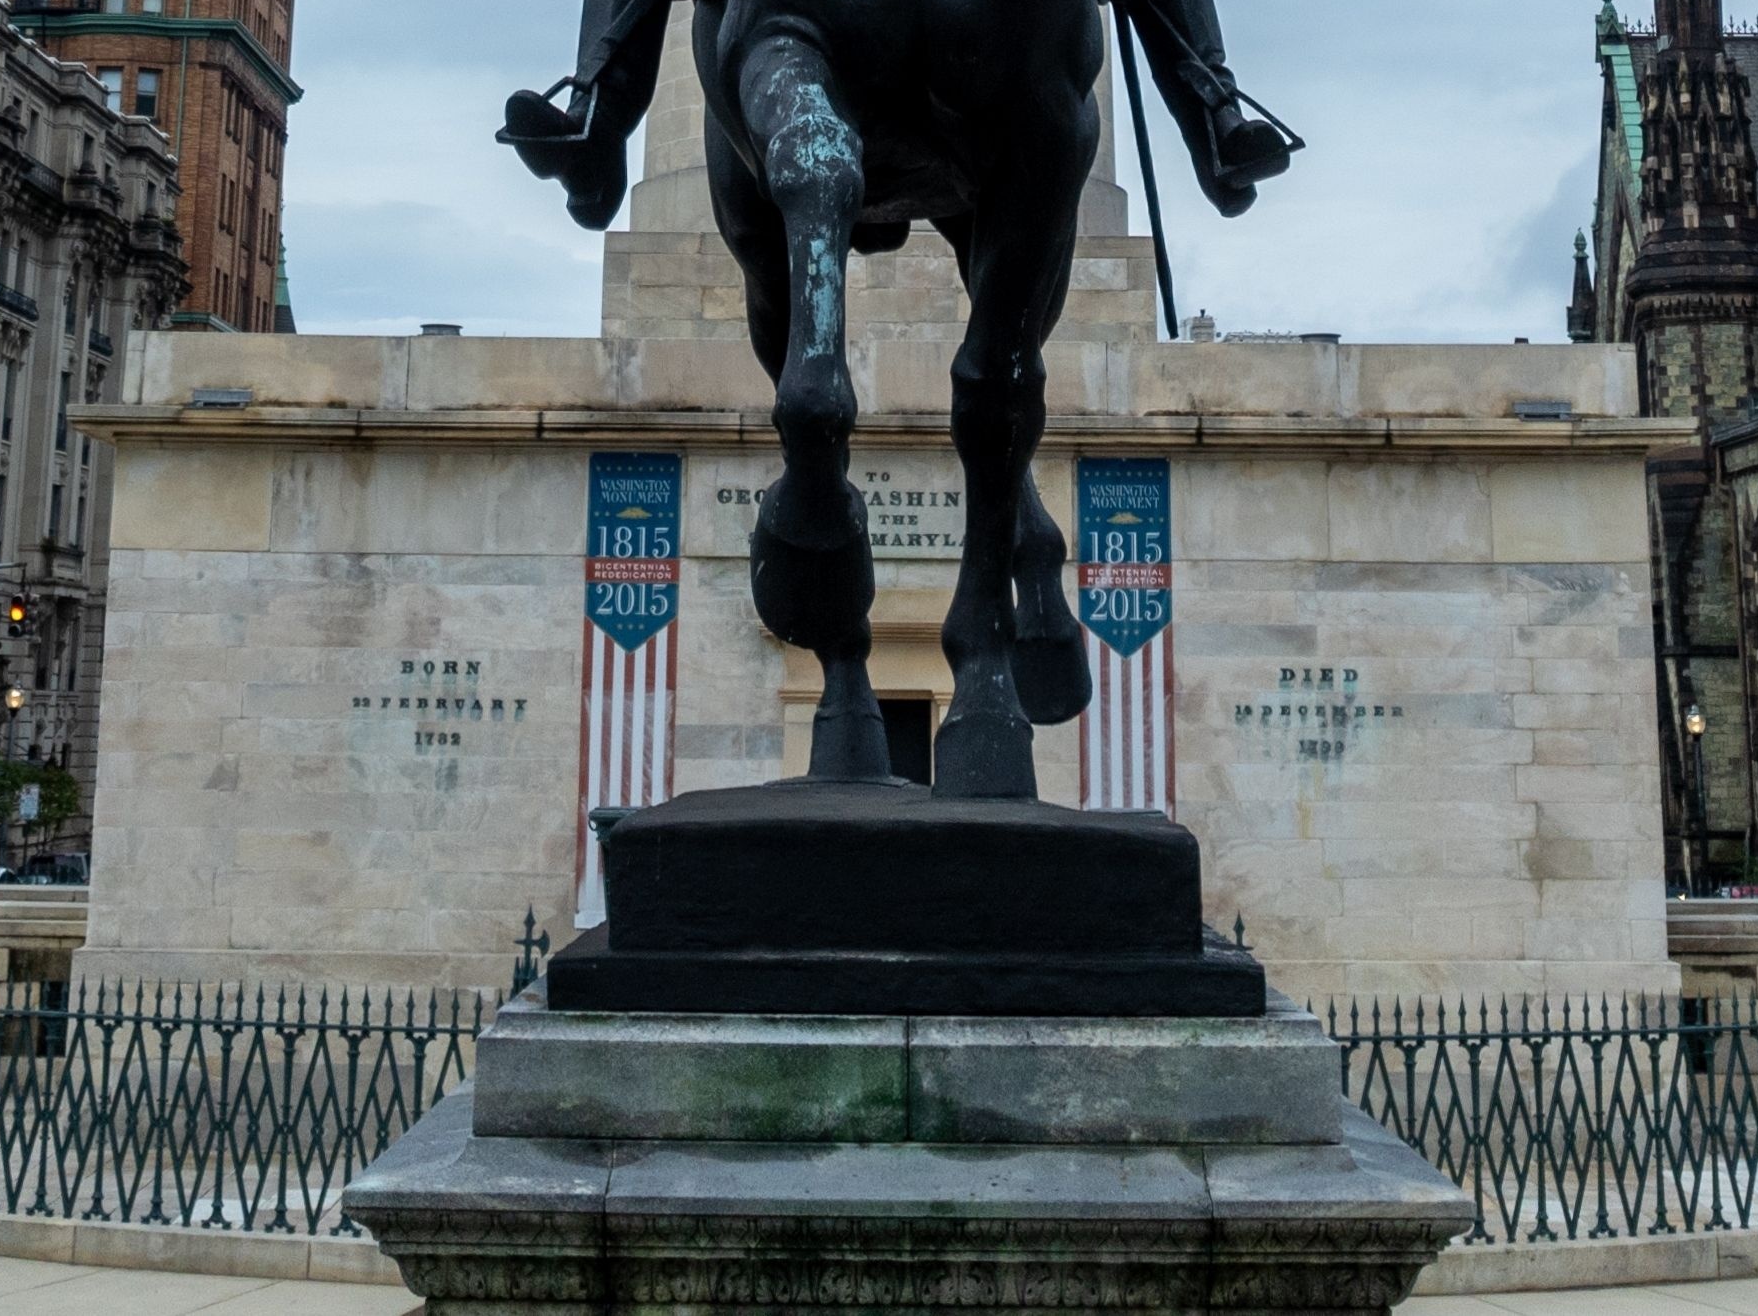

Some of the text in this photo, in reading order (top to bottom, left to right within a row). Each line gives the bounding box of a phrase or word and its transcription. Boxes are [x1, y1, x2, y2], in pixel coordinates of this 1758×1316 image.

[865, 471, 891, 483] TO
[600, 479, 671, 491] WASHINGTON
[1088, 484, 1160, 497] WASHINGTON
[601, 491, 670, 504] MONUMENT
[716, 488, 767, 505] GEO
[1090, 496, 1160, 509] MONUMENT
[878, 514, 919, 526] THE
[595, 525, 671, 559] 1815
[870, 533, 965, 548] MARYL
[1087, 531, 1163, 565] 1815
[594, 562, 672, 571] BICENTENNIAL
[1087, 568, 1164, 577] BICENTENNIAL
[594, 571, 672, 580] REDEDICATION
[1087, 577, 1165, 586] REDEDICATION
[595, 582, 669, 617] 2015
[1089, 588, 1163, 622] 2015
[401, 660, 482, 675] BORN
[1279, 667, 1359, 682] DIED
[352, 697, 528, 711] 22 FEBRUARY
[1260, 704, 1404, 718] DECEMBER
